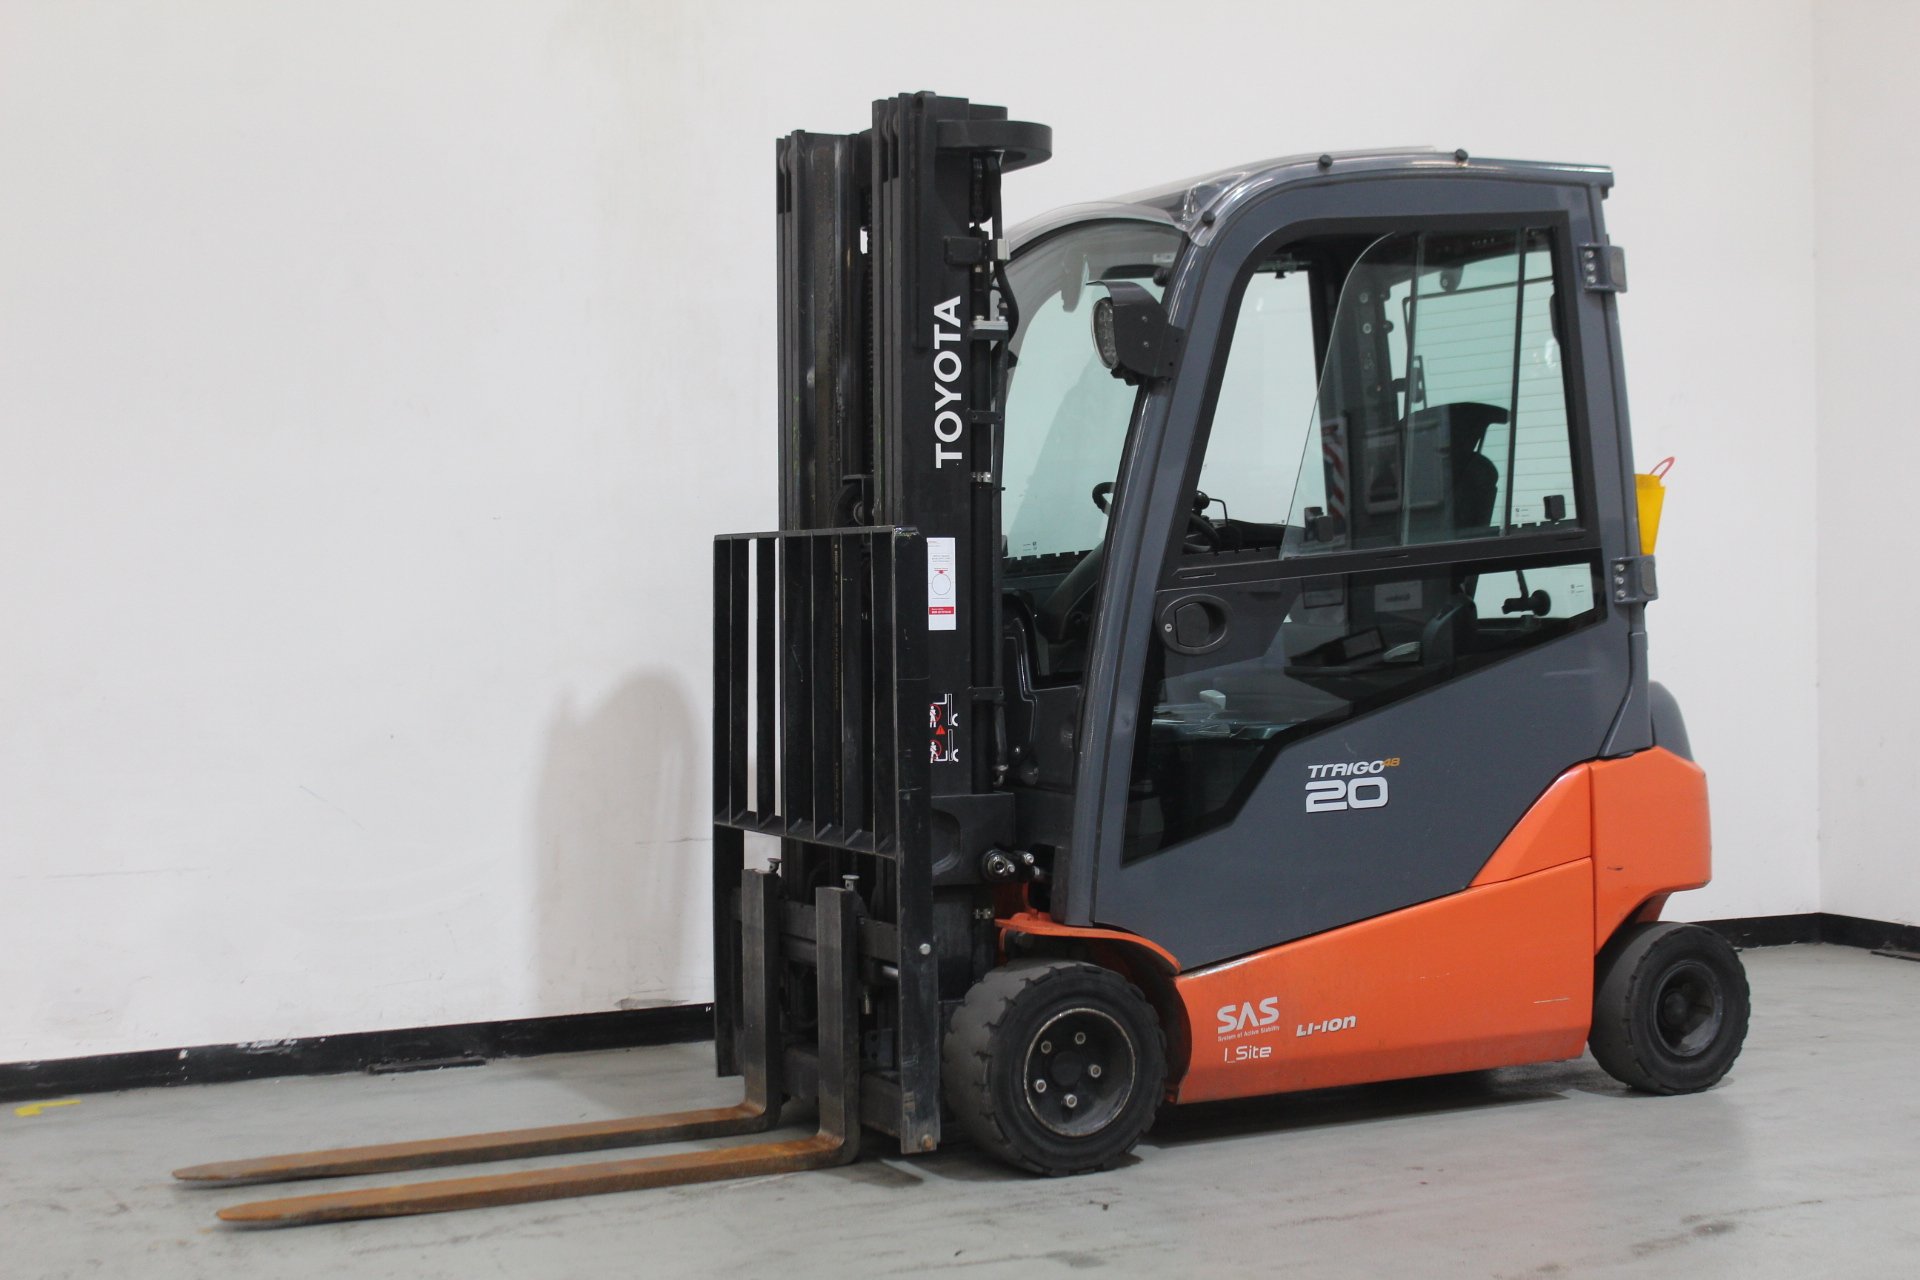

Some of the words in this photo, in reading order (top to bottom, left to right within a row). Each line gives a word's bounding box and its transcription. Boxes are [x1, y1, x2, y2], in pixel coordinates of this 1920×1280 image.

[933, 295, 963, 469] TOYOTA
[1305, 776, 1389, 813] 20
[1217, 996, 1279, 1034] SAS
